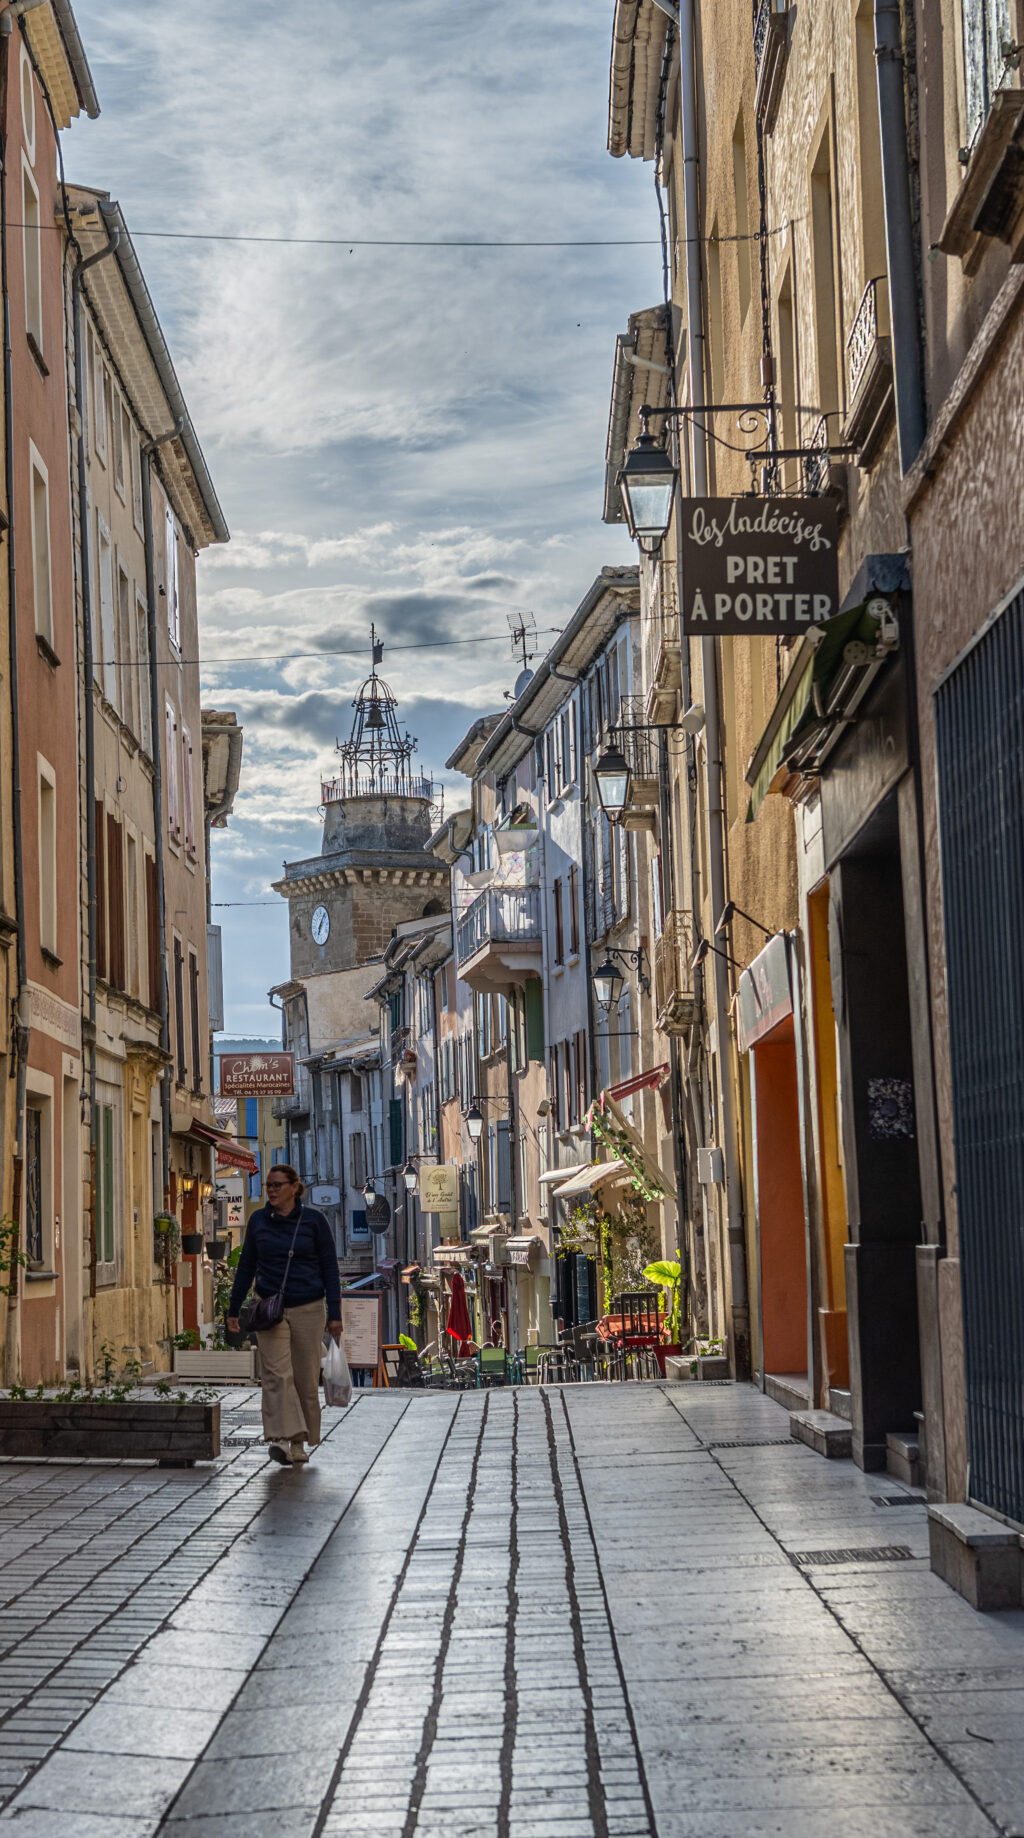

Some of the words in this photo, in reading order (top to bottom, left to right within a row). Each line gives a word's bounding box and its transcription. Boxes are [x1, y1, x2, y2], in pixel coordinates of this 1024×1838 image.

[727, 556, 798, 584] PRET
[715, 593, 832, 621] PORTER
[226, 1073, 288, 1083] RESTAURANT
